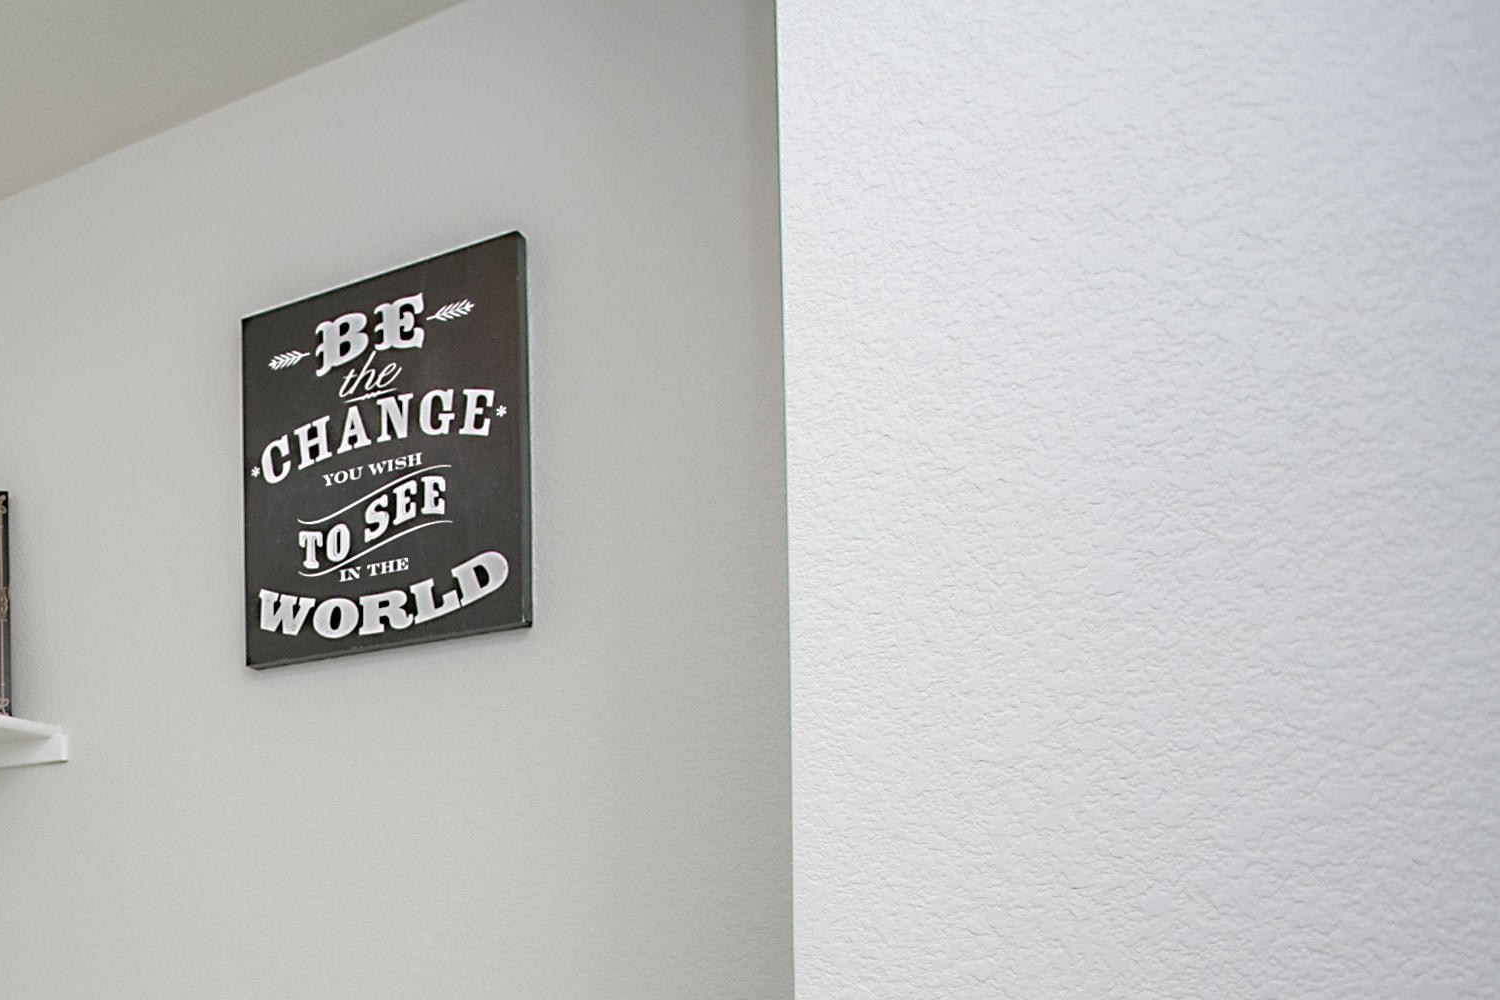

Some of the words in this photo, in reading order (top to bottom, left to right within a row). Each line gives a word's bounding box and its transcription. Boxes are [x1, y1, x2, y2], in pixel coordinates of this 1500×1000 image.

[315, 292, 426, 377] BE
[338, 351, 402, 399] the
[260, 388, 495, 484] CHANGE
[323, 464, 364, 487] YOU
[368, 452, 423, 477] WISH
[299, 523, 351, 570] TO
[364, 475, 447, 543] SEE
[258, 550, 510, 639] WORLD
[339, 564, 361, 582] IN
[367, 557, 409, 581] THE
